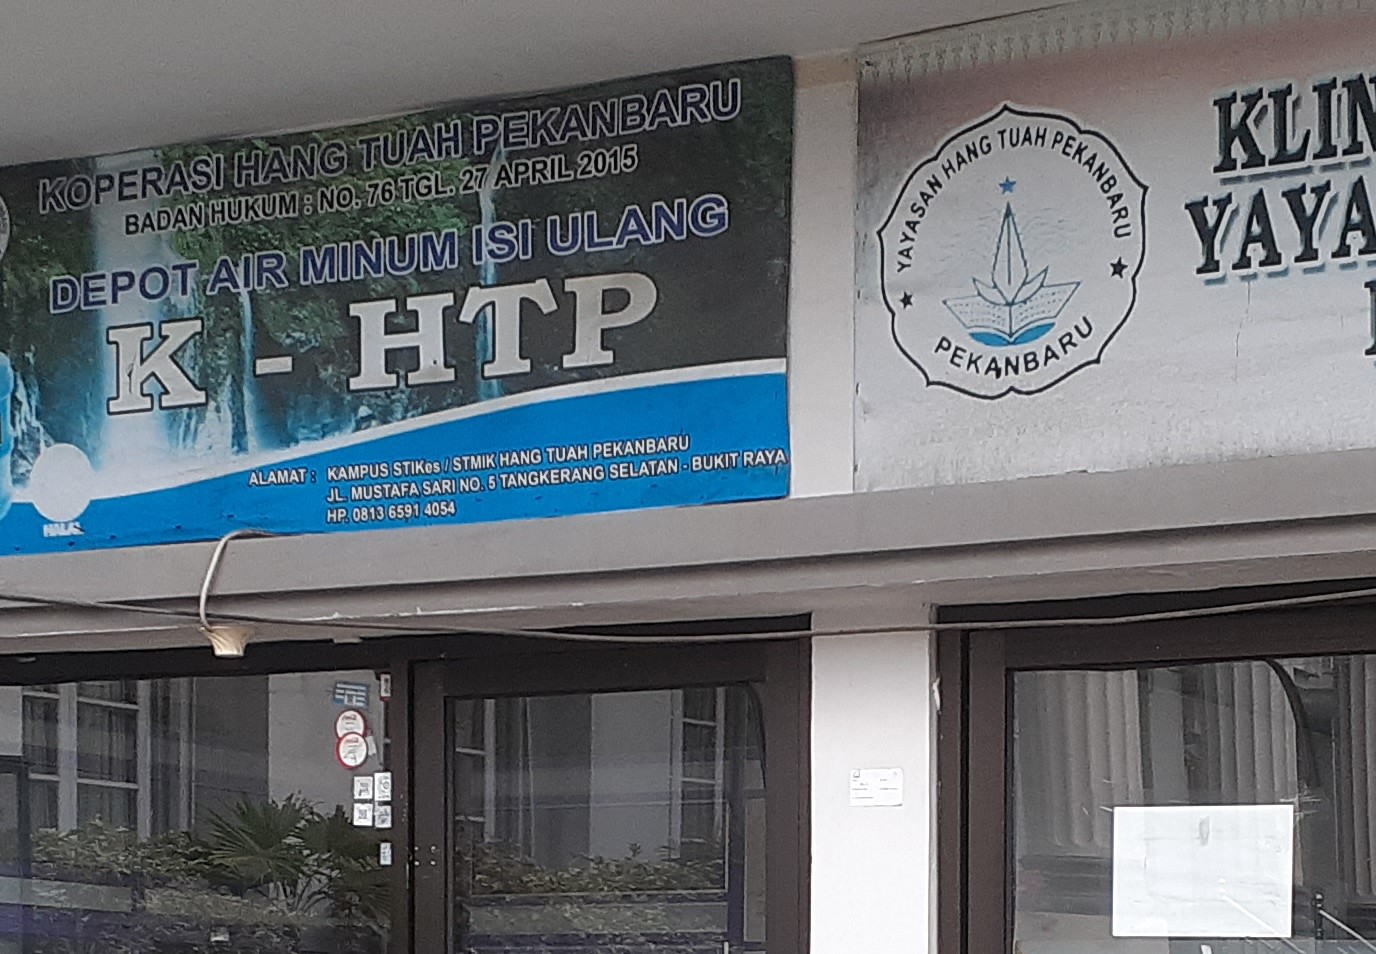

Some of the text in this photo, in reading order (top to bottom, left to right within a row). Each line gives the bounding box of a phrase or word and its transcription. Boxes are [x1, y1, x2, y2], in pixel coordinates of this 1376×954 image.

[39, 155, 224, 214] KOPERASI
[234, 142, 348, 188] HANG
[358, 119, 462, 172] TUAH
[474, 78, 742, 155] PEKANBARU
[124, 144, 639, 235] BADAN HUKUM : NO. 76 TGL. 27 APRIL 2015
[896, 126, 1132, 274] YAYASAN HANG TUAH PEKANBARU
[49, 194, 729, 315] DEPOT AIR MINUM ISI ULANG
[106, 318, 207, 416] K
[347, 271, 659, 393] HTP
[934, 316, 1094, 378] PEKANBARU
[248, 467, 307, 486] ALAMAT
[327, 461, 388, 481] KAMPUS
[452, 452, 496, 473] STMIK
[499, 448, 542, 468] HANG
[546, 445, 588, 463] TUAH
[592, 434, 691, 459] PEKANBARU
[327, 485, 348, 502] JL.
[350, 482, 420, 502] MUSTAFA
[422, 477, 456, 497] SARI
[459, 476, 485, 494] NO.
[488, 476, 496, 491] 5
[499, 465, 605, 490] TANGKERANG
[608, 458, 679, 481] SELATAN
[691, 452, 740, 472] BUKIT
[743, 448, 787, 467] RAYA
[327, 500, 456, 524] HP. 0813 6591 4054
